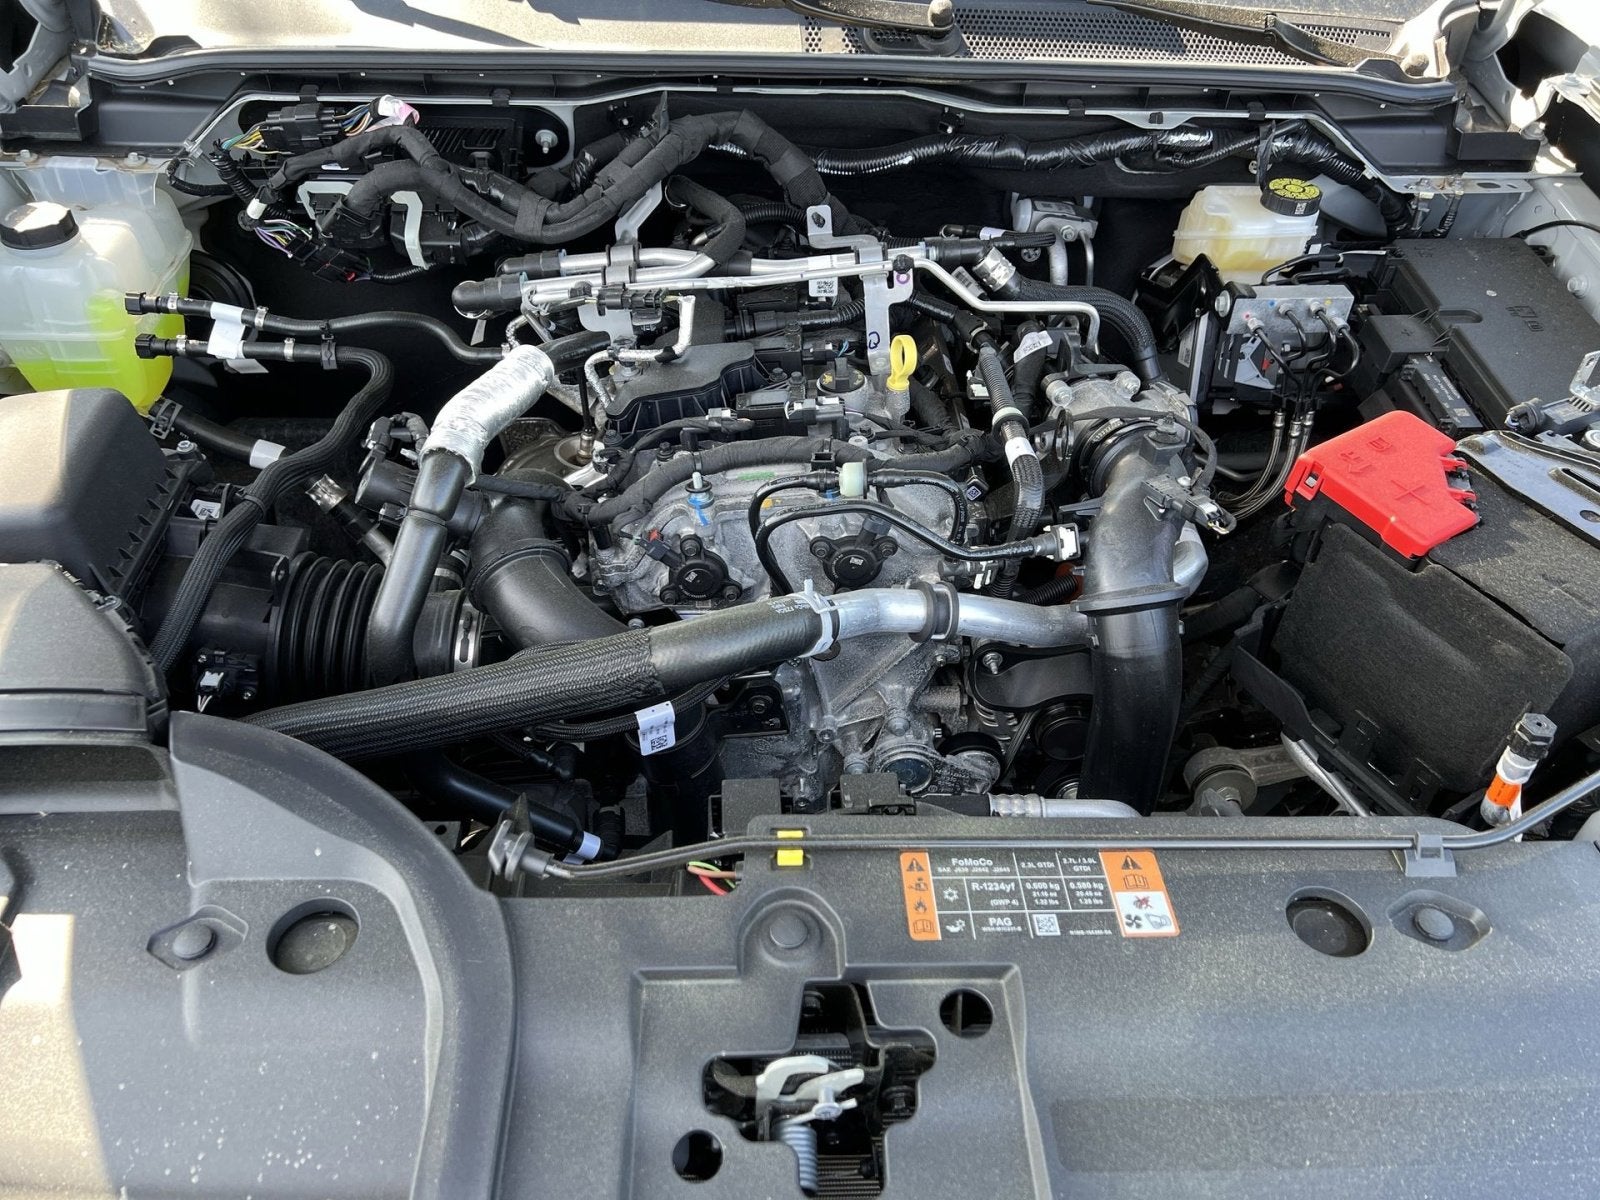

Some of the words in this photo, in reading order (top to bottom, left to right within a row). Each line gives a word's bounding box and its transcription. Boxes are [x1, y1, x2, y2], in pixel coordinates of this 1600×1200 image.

[951, 857, 993, 866] FoMoCo
[971, 882, 1015, 892] R-1234yf
[1049, 882, 1060, 890] kg
[1093, 882, 1104, 890] kg
[988, 917, 1013, 926] PAG
